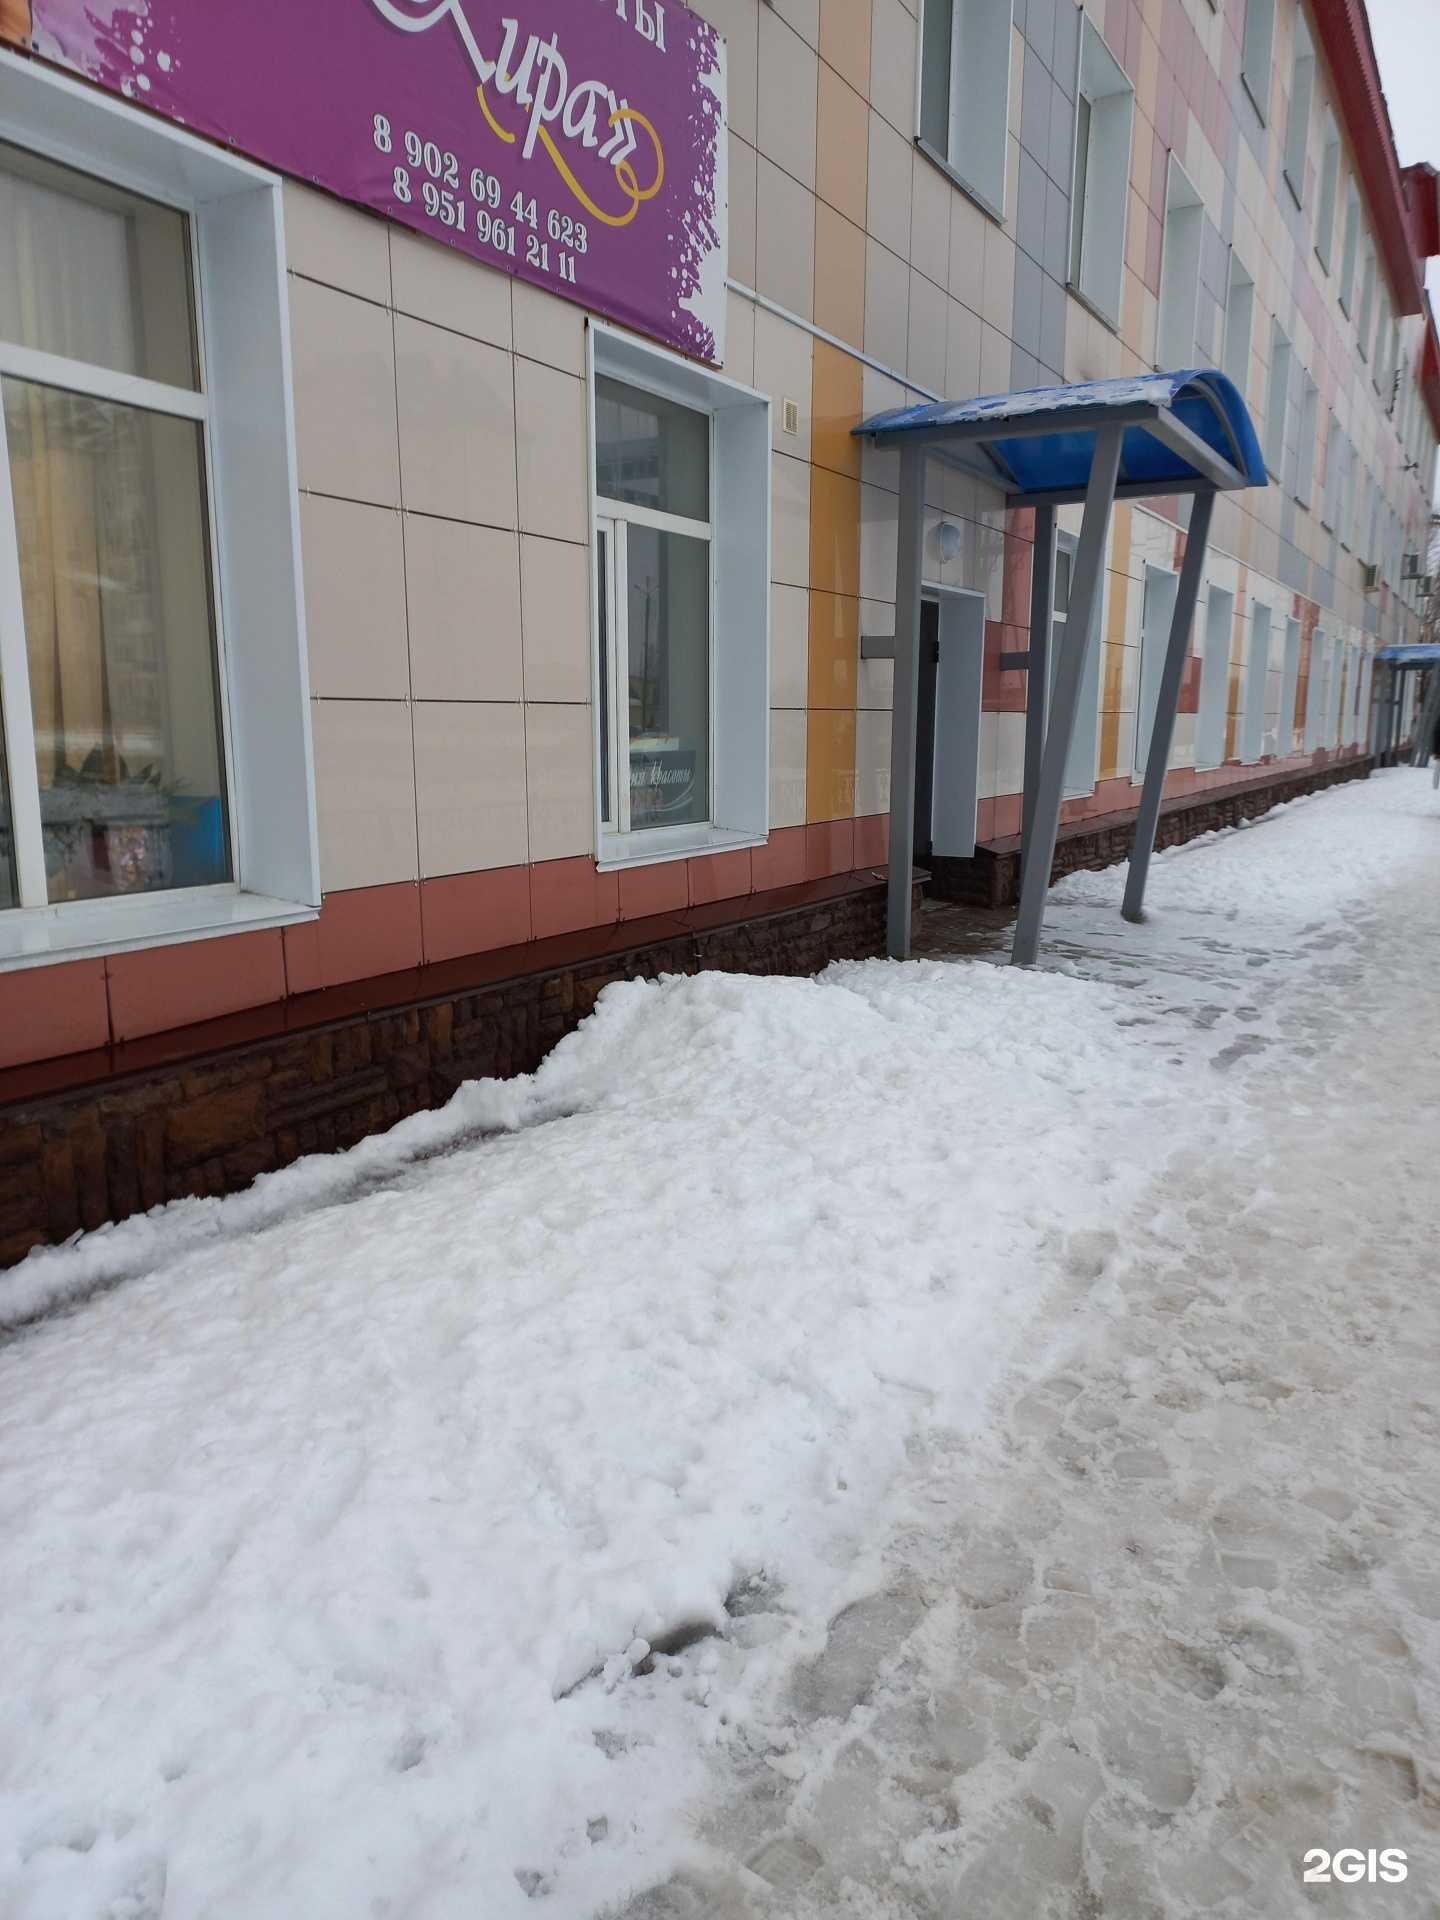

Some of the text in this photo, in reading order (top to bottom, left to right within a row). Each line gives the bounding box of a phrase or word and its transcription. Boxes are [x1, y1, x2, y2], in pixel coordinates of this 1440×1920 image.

[373, 113, 588, 254] 8 902 69 44 623
[393, 166, 576, 284] 8 951 961 21 11
